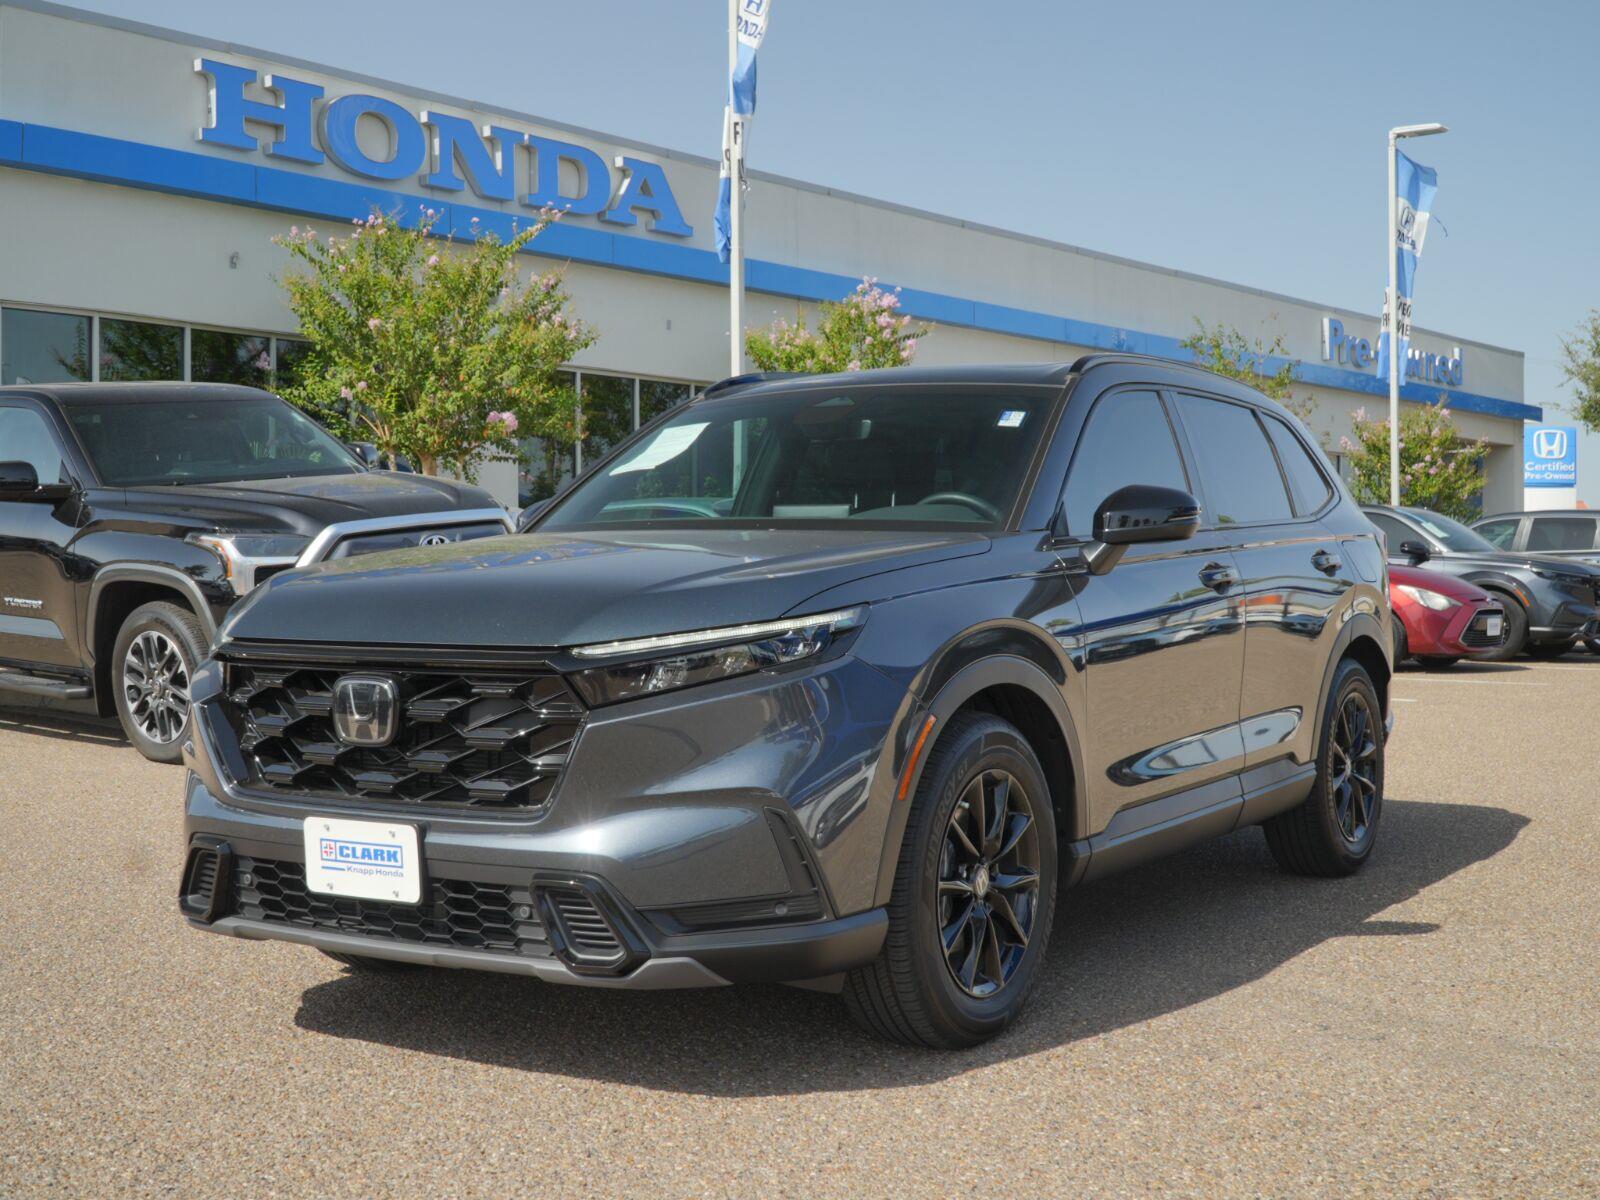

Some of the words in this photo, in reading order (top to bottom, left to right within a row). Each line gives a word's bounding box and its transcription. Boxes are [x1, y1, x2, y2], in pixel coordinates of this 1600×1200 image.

[194, 58, 693, 237] HONDA
[1321, 317, 1463, 386] Pre-wned
[1525, 461, 1575, 472] Certified
[1525, 472, 1575, 480] Pre-Owned
[338, 845, 398, 863] CLARK
[346, 864, 375, 876] Knapp
[375, 868, 404, 878] Honda
